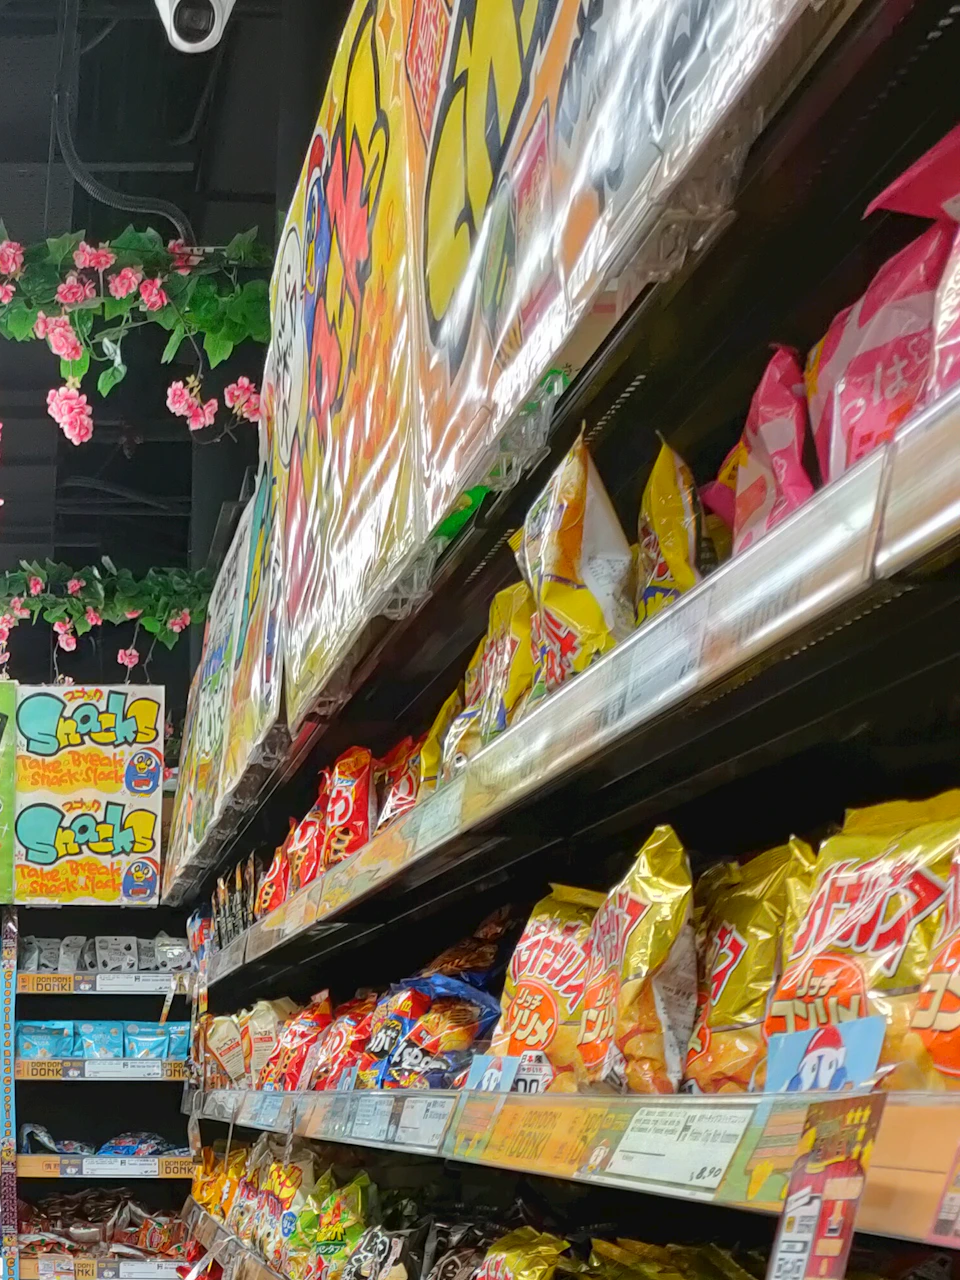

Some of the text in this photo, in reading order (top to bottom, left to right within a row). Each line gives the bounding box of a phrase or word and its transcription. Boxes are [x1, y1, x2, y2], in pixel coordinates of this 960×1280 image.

[16, 690, 161, 757] Snacks
[16, 755, 63, 774] Take
[68, 750, 125, 769] Break
[15, 801, 158, 866] Snacks
[15, 864, 62, 883] Take
[66, 860, 122, 878] Break
[31, 1068, 62, 1077] DONK
[164, 1166, 193, 1175] DONK
